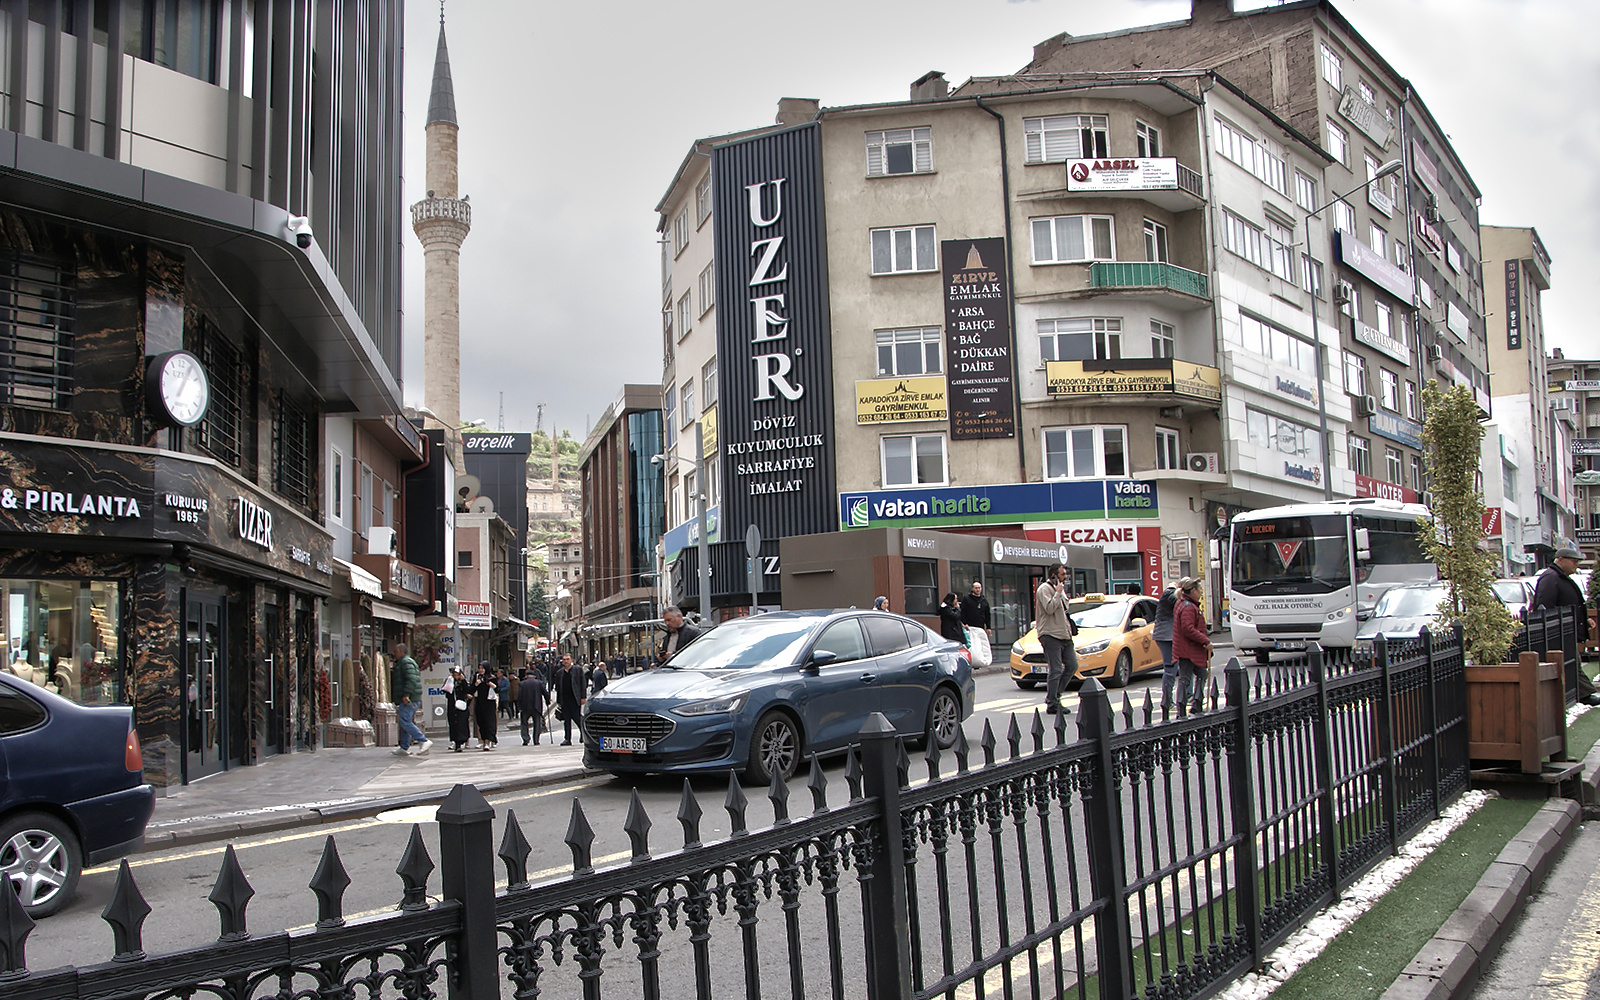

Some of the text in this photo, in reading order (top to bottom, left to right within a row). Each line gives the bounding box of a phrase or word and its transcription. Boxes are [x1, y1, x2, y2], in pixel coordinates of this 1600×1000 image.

[1091, 159, 1139, 171] ARSEL
[745, 178, 804, 402] UZER
[950, 283, 1001, 295] EMLAK
[1508, 263, 1516, 307] HOTEL
[958, 306, 985, 317] ARSA
[959, 319, 996, 332] BAHÇE
[959, 333, 981, 345] BAĞ
[960, 347, 1007, 359] DÜKKAN
[178, 359, 185, 368] 12
[961, 360, 995, 373] DAİRE
[859, 392, 944, 405] KAPADOKYA ZİRVE EMLAK
[874, 402, 929, 413] GAYRİMENKUL
[904, 411, 919, 420] 0533
[930, 410, 939, 418] 67
[752, 414, 797, 432] DÖVİZ
[466, 435, 516, 451] arçelik
[727, 434, 823, 457] KUYUMCULUK
[737, 456, 815, 476] SARRAFİYE
[750, 479, 803, 496] İMALAT
[1369, 481, 1403, 502] 1. NOTER
[1, 488, 141, 518] & PIRLANTA
[165, 494, 208, 512] KURULUŞ
[931, 495, 991, 515] harita
[1115, 494, 1151, 508] harita
[176, 510, 199, 523] 1965
[238, 495, 274, 552] UZER
[1484, 508, 1499, 535] Canon
[1060, 527, 1134, 544] ECZANE
[907, 538, 936, 549] NEVKART
[1175, 541, 1187, 556] E
[1004, 545, 1059, 559] NEVŞEHİR BELEDİYESİ
[1290, 601, 1323, 609] OTOBÜSÜ
[603, 738, 646, 750] 50 AAE 687
